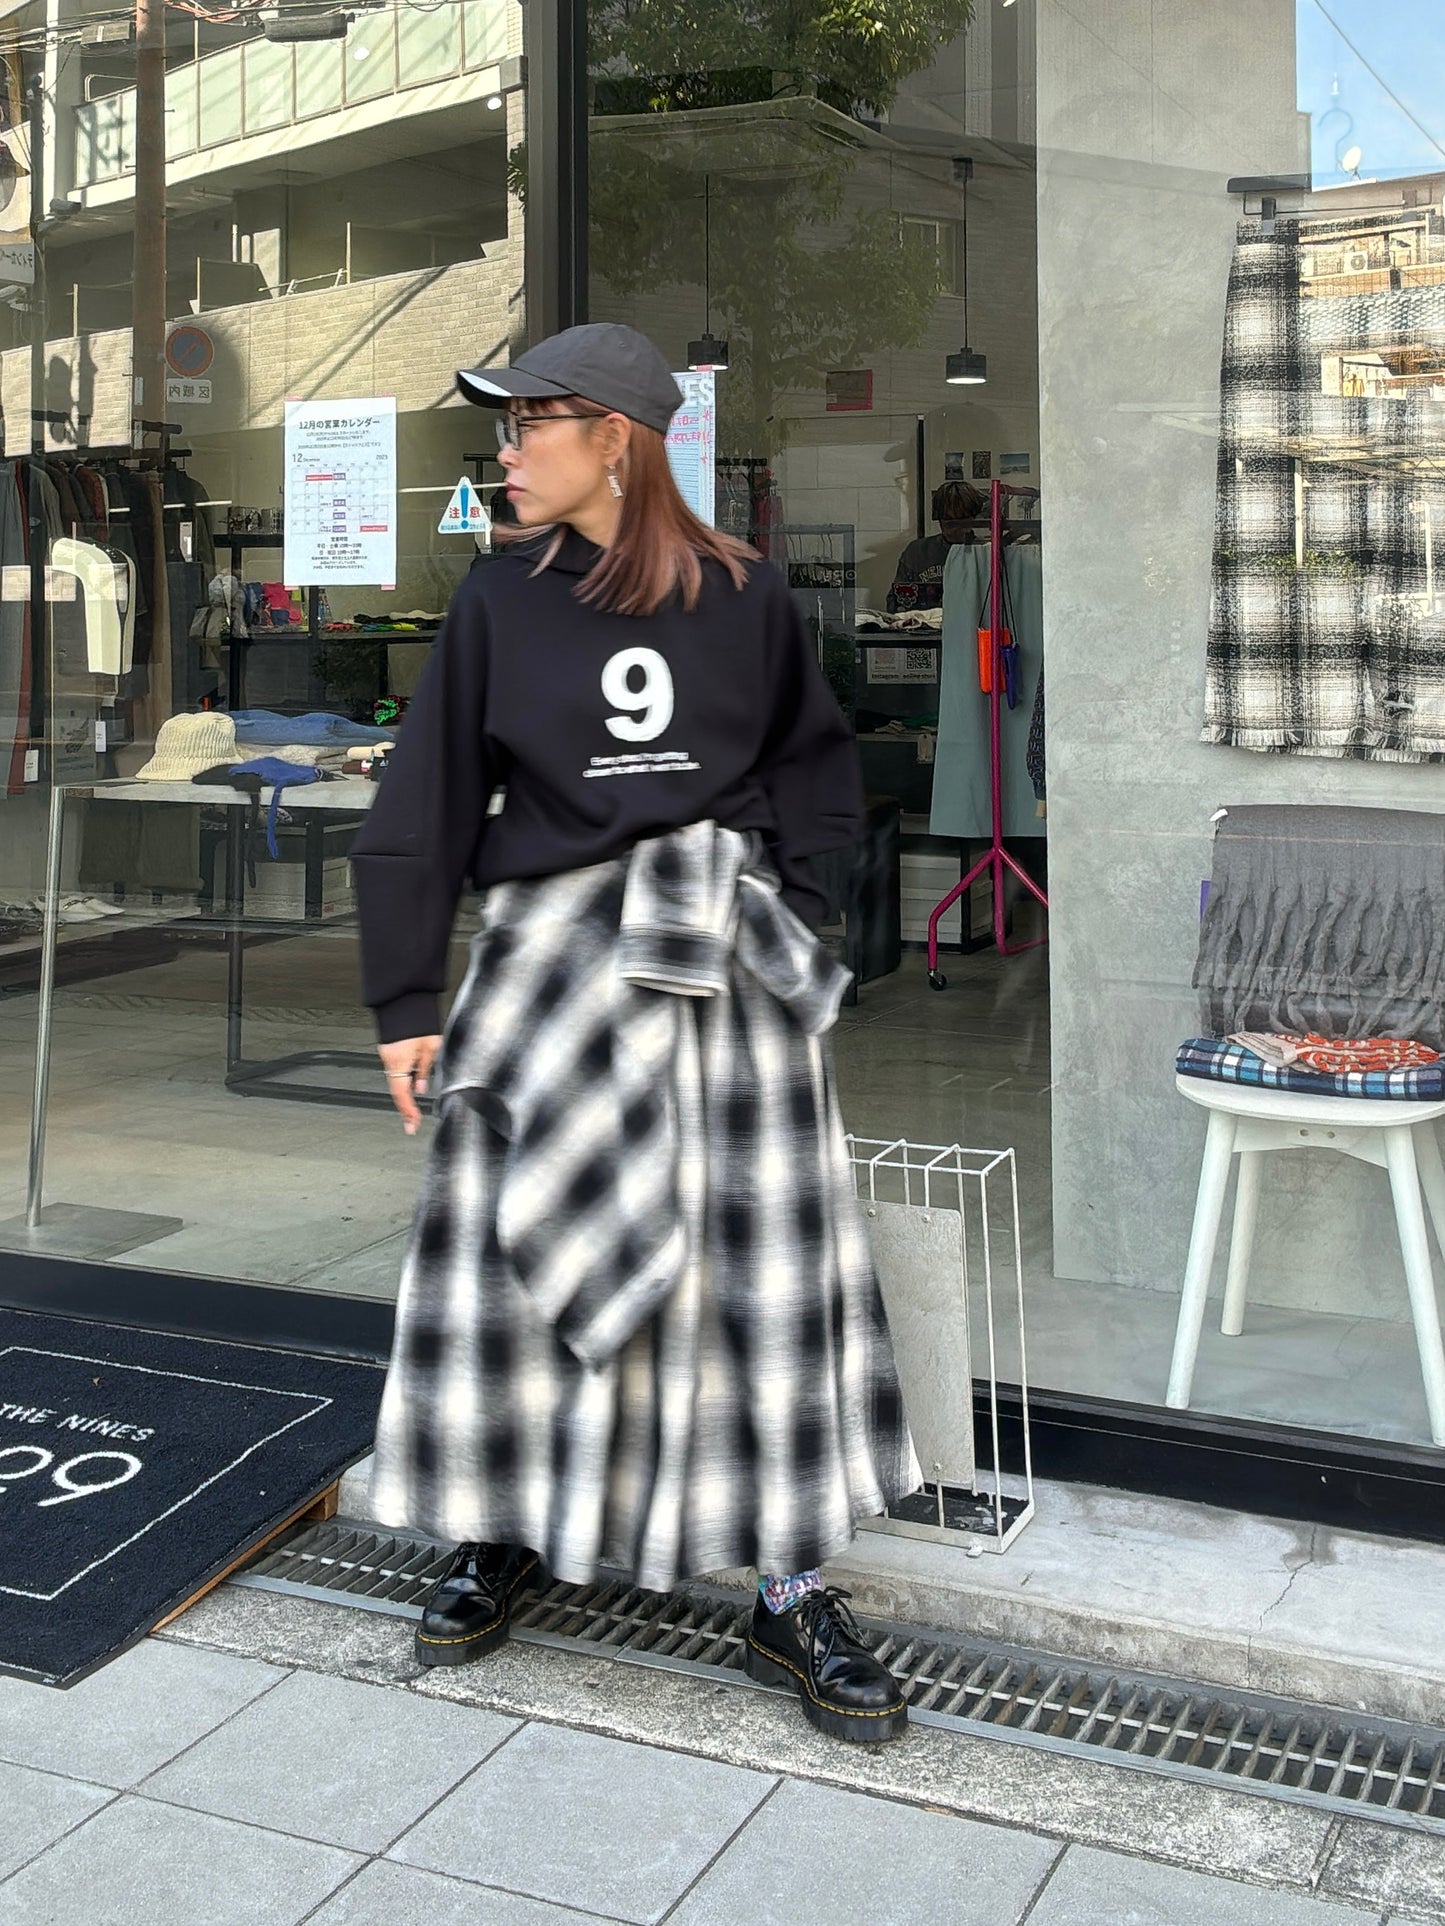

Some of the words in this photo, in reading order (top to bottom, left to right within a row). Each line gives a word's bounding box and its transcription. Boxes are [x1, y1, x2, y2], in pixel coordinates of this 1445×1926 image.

[299, 417, 381, 430] 12月の営業カレンダー
[601, 647, 675, 742] 9
[0, 1403, 57, 1423] THE
[57, 1413, 155, 1442] NINES
